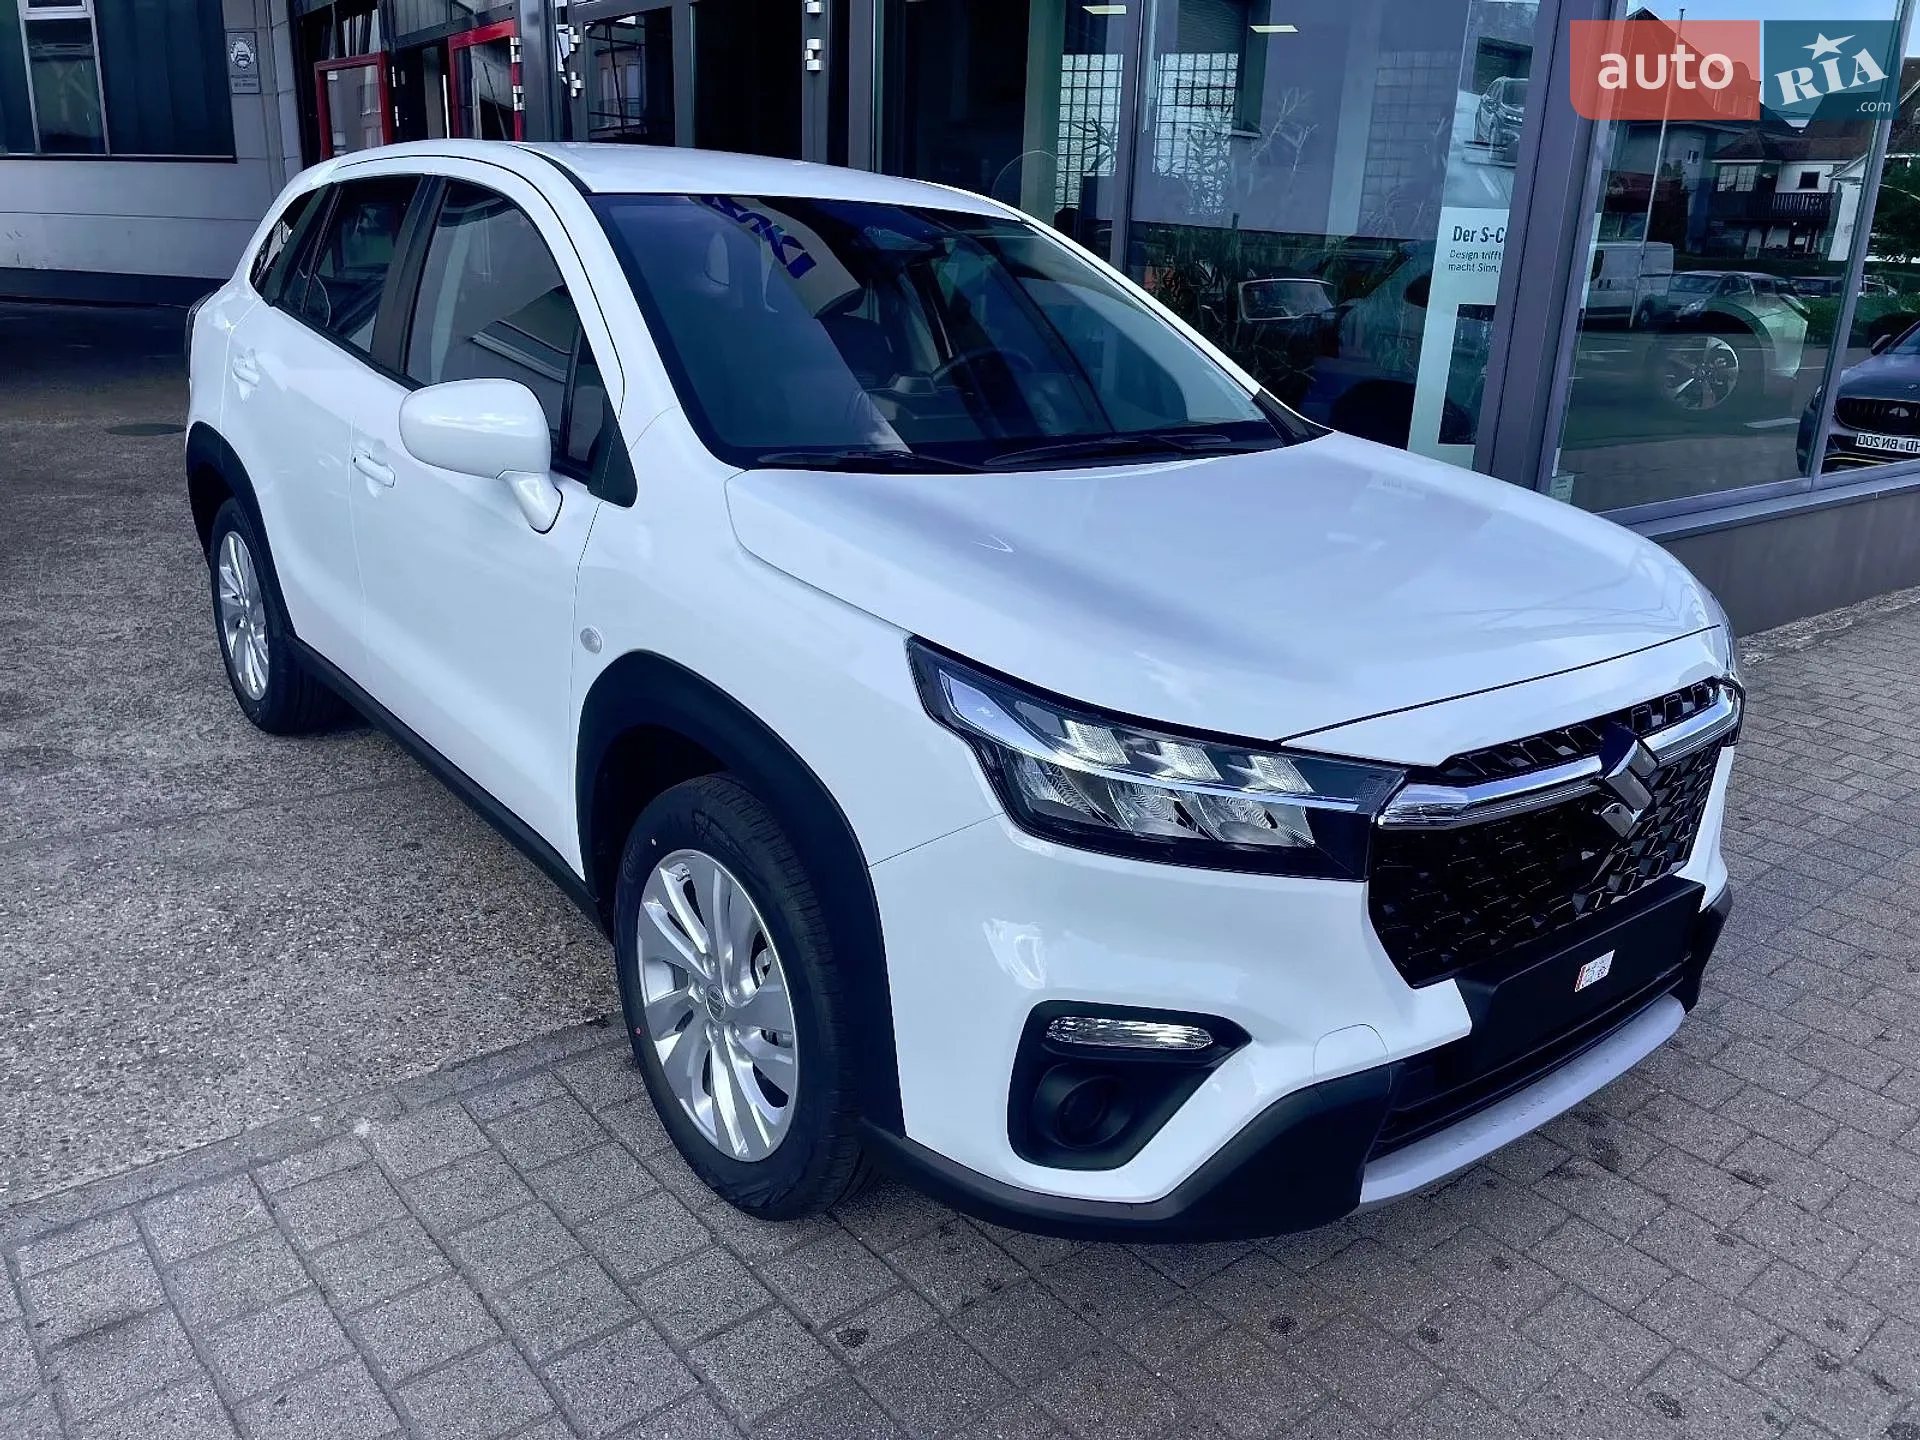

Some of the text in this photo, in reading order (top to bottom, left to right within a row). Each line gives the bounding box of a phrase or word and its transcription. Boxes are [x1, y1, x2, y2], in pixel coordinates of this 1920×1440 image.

[1453, 226, 1477, 242] Der
[1450, 250, 1479, 261] Design
[1448, 263, 1475, 272] macht
